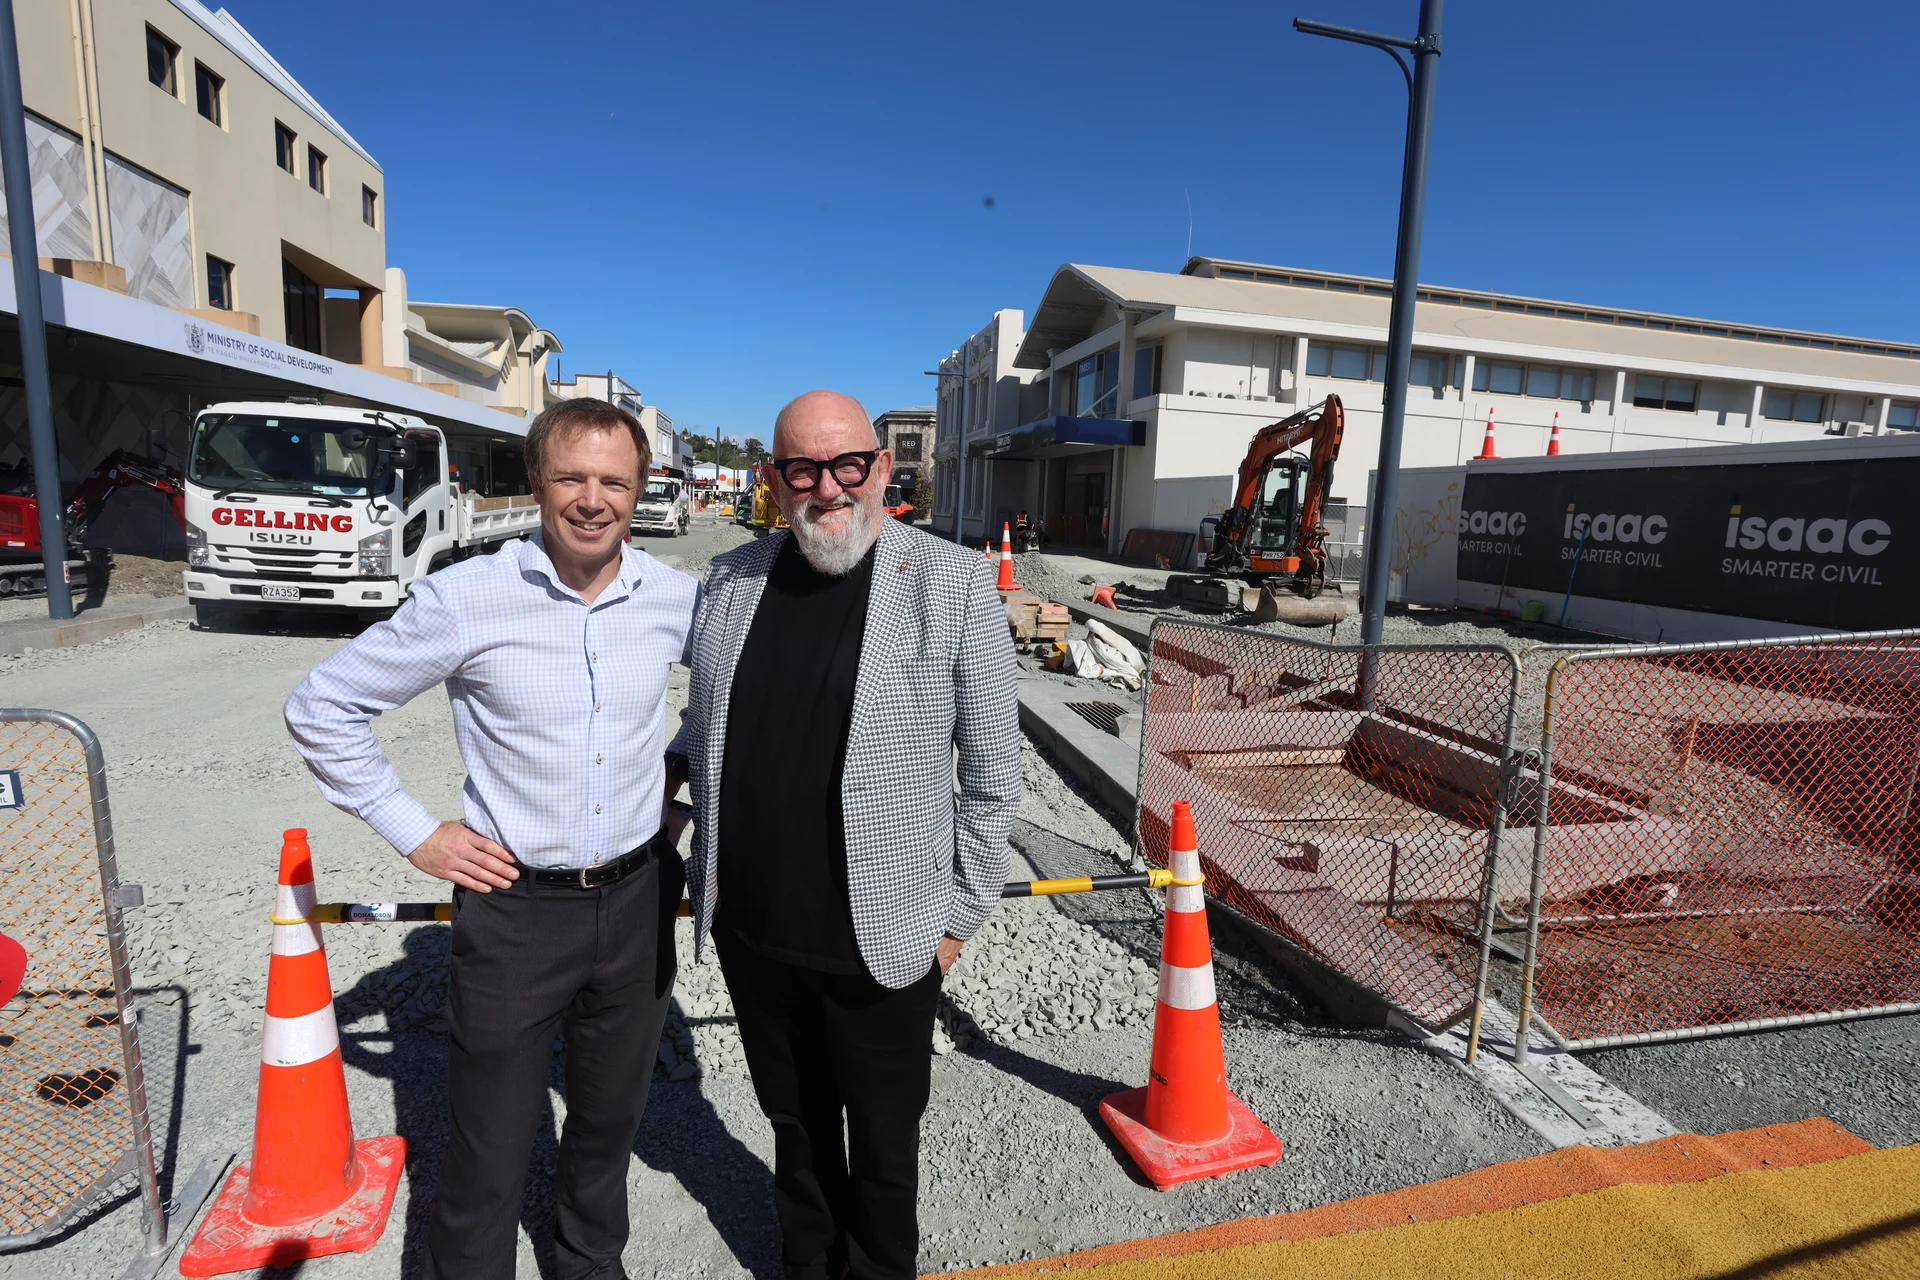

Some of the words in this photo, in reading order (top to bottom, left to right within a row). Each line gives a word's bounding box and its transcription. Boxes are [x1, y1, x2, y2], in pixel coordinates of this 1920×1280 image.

[207, 332, 246, 352] MINISTRY
[248, 344, 259, 355] OF
[260, 347, 286, 363] SOCIAL
[287, 355, 333, 376] DEVELOPMENT
[212, 507, 353, 533] GELLING
[1459, 510, 1527, 537] saac
[1563, 503, 1668, 545] isaac
[1725, 504, 1892, 556] isaac
[249, 532, 312, 545] ISUZU
[1561, 547, 1621, 564] SMARTER
[1625, 551, 1663, 568] CIVIL
[1721, 557, 1815, 580] SMARTER
[1821, 564, 1882, 586] CIVIL
[262, 587, 299, 598] RZA352
